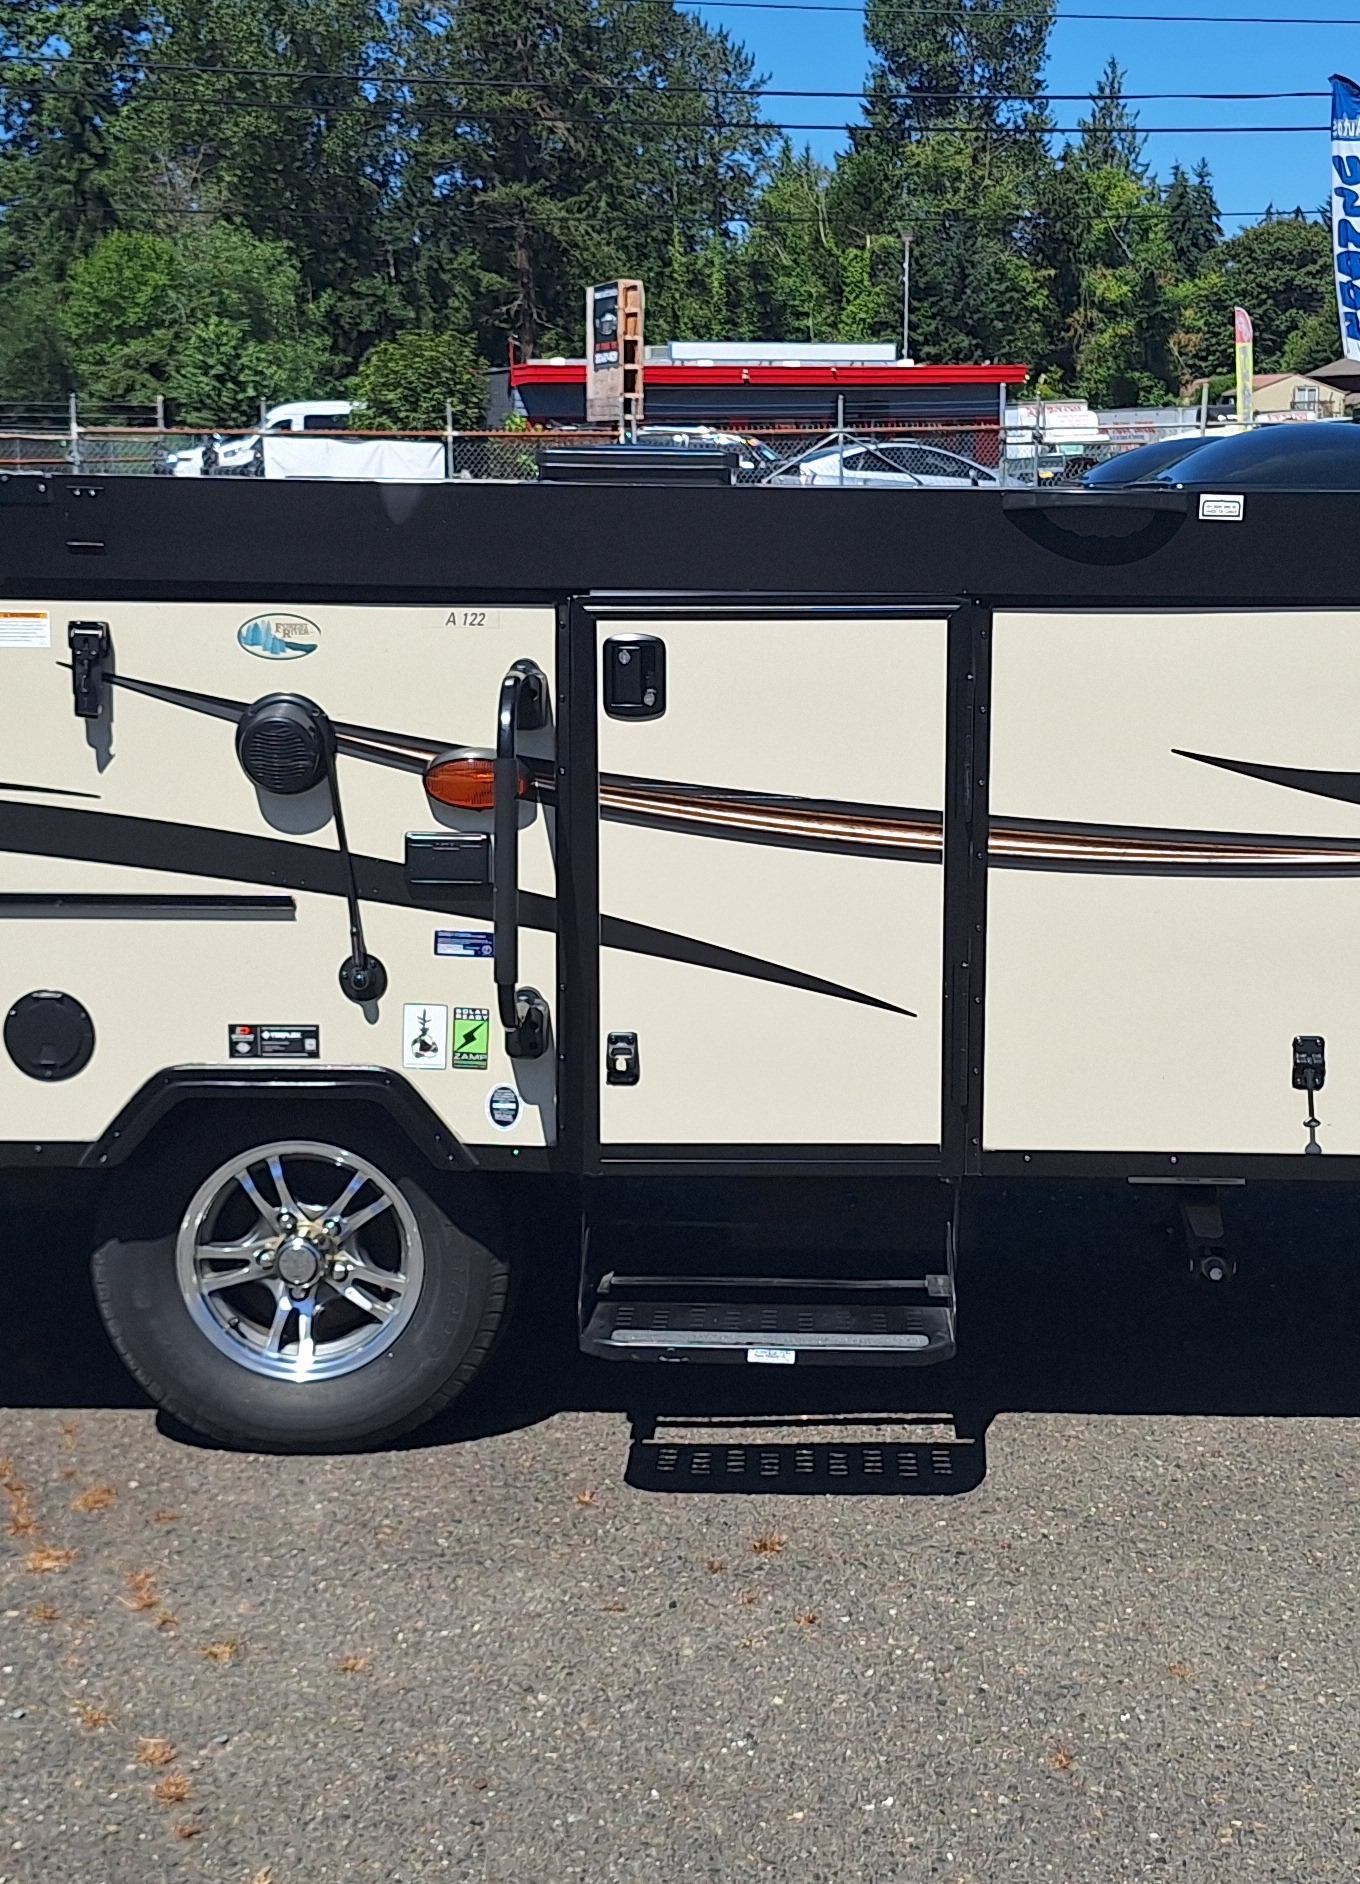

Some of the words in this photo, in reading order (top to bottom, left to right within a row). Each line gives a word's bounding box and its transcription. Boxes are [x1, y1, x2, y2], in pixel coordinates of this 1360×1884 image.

[445, 611, 457, 626] A
[463, 612, 487, 626] 122
[453, 1052, 487, 1061] ZAMP
